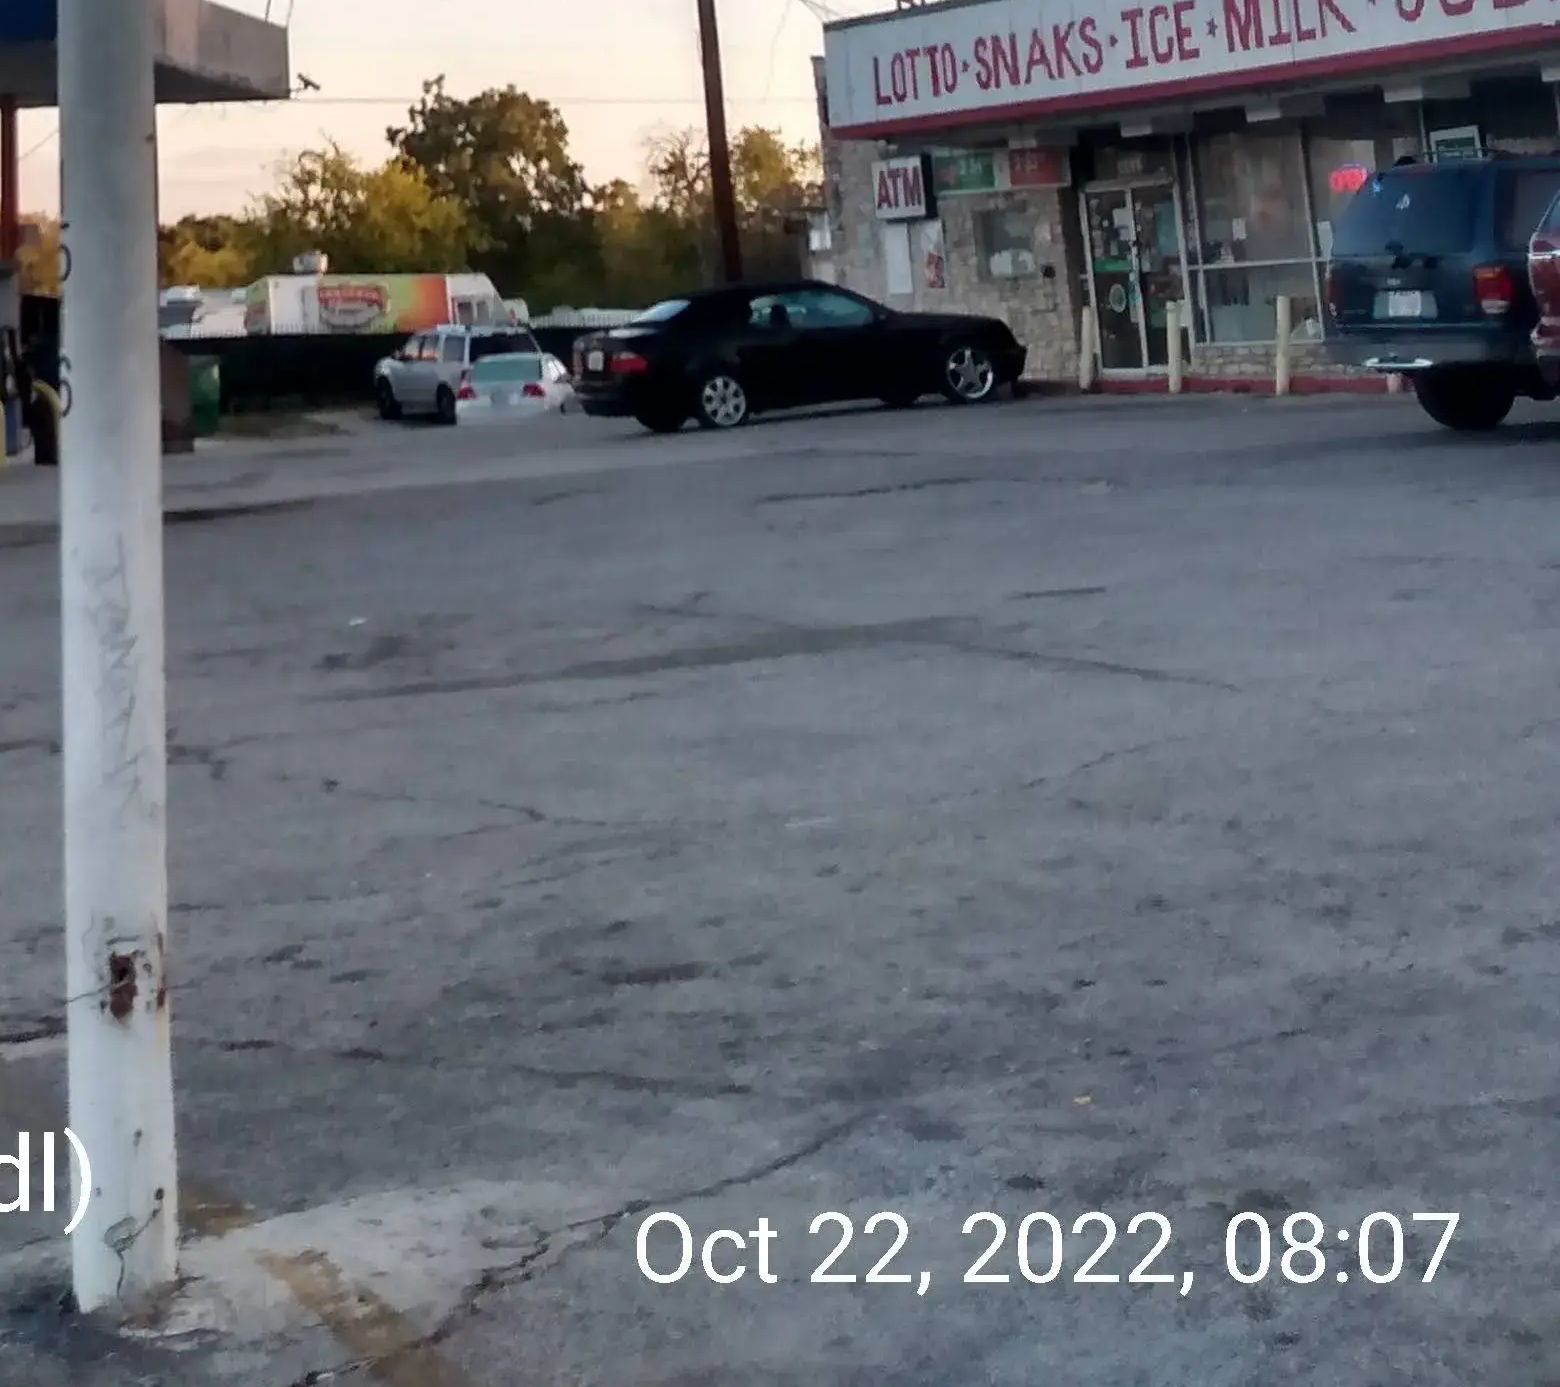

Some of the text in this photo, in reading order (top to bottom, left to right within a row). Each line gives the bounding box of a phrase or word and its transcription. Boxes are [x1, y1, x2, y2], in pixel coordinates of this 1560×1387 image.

[872, 42, 958, 106] LOTTO
[973, 15, 1104, 91] SNAKS
[876, 165, 923, 210] ATM
